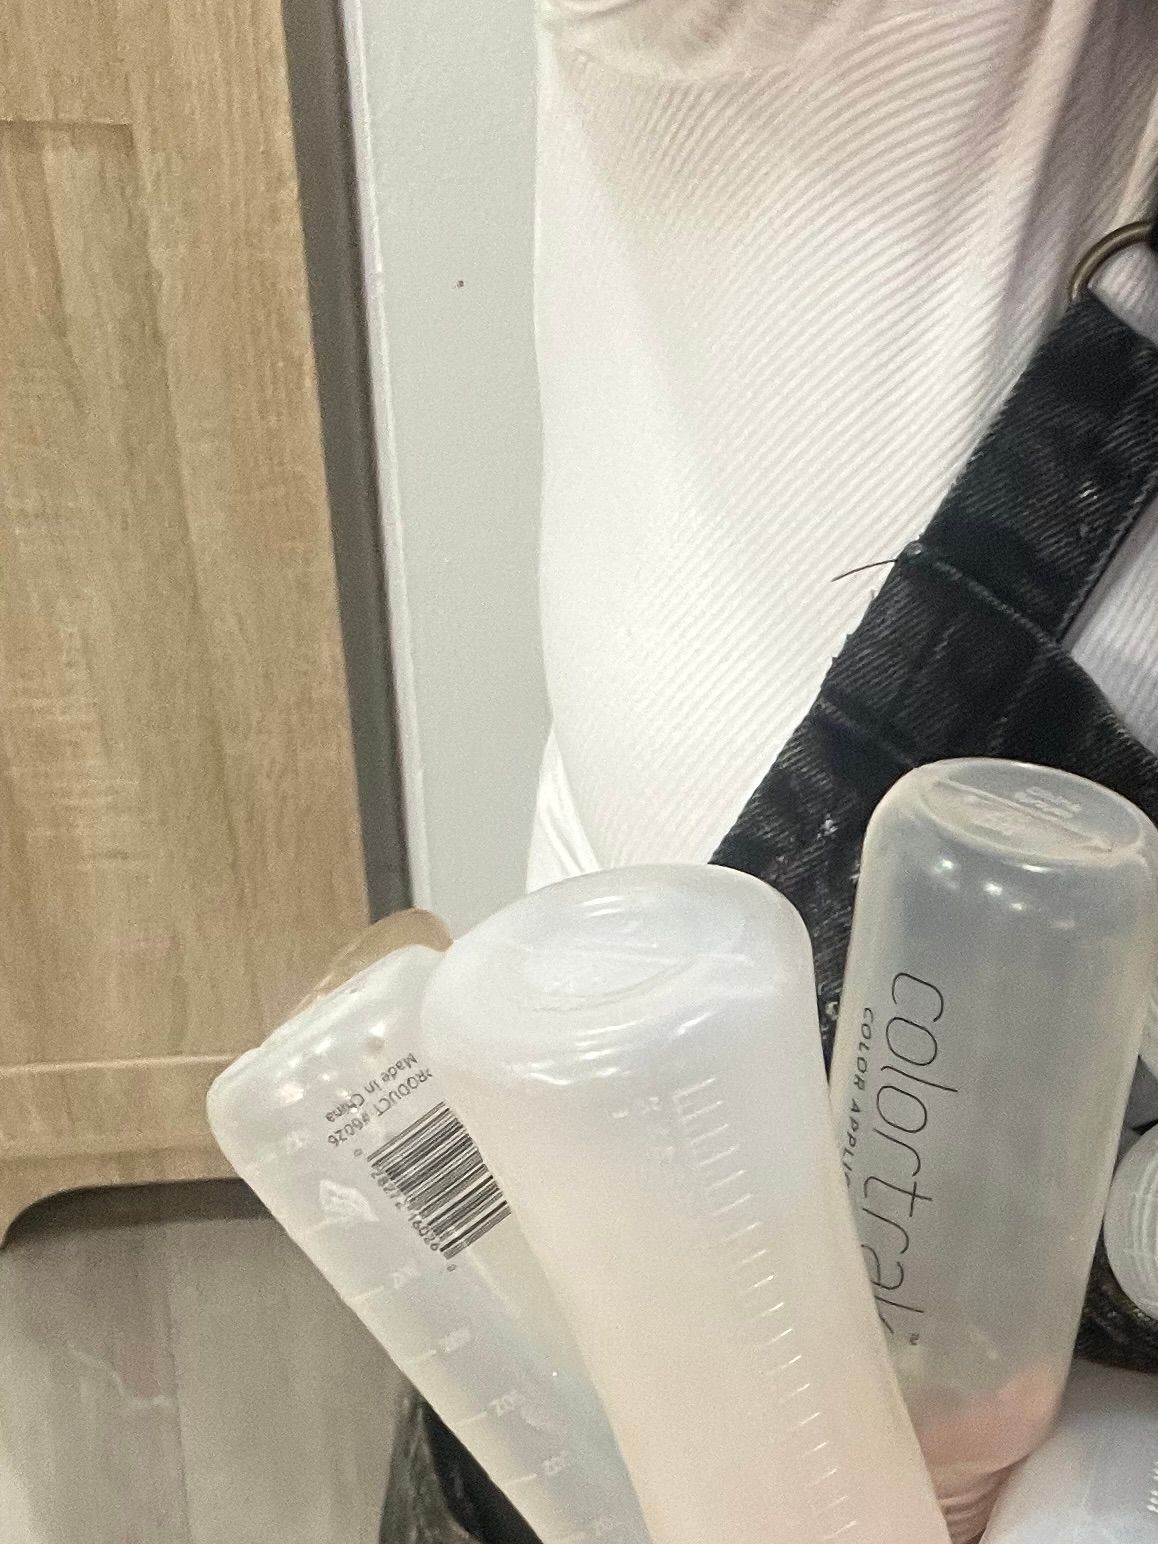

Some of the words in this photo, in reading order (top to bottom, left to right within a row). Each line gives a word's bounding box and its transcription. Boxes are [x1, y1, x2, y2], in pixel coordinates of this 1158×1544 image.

[854, 1006, 874, 1090] COLOR
[382, 1053, 418, 1082] Made
[364, 1080, 383, 1094] in
[326, 1093, 365, 1123] China
[328, 1113, 371, 1147] #6026
